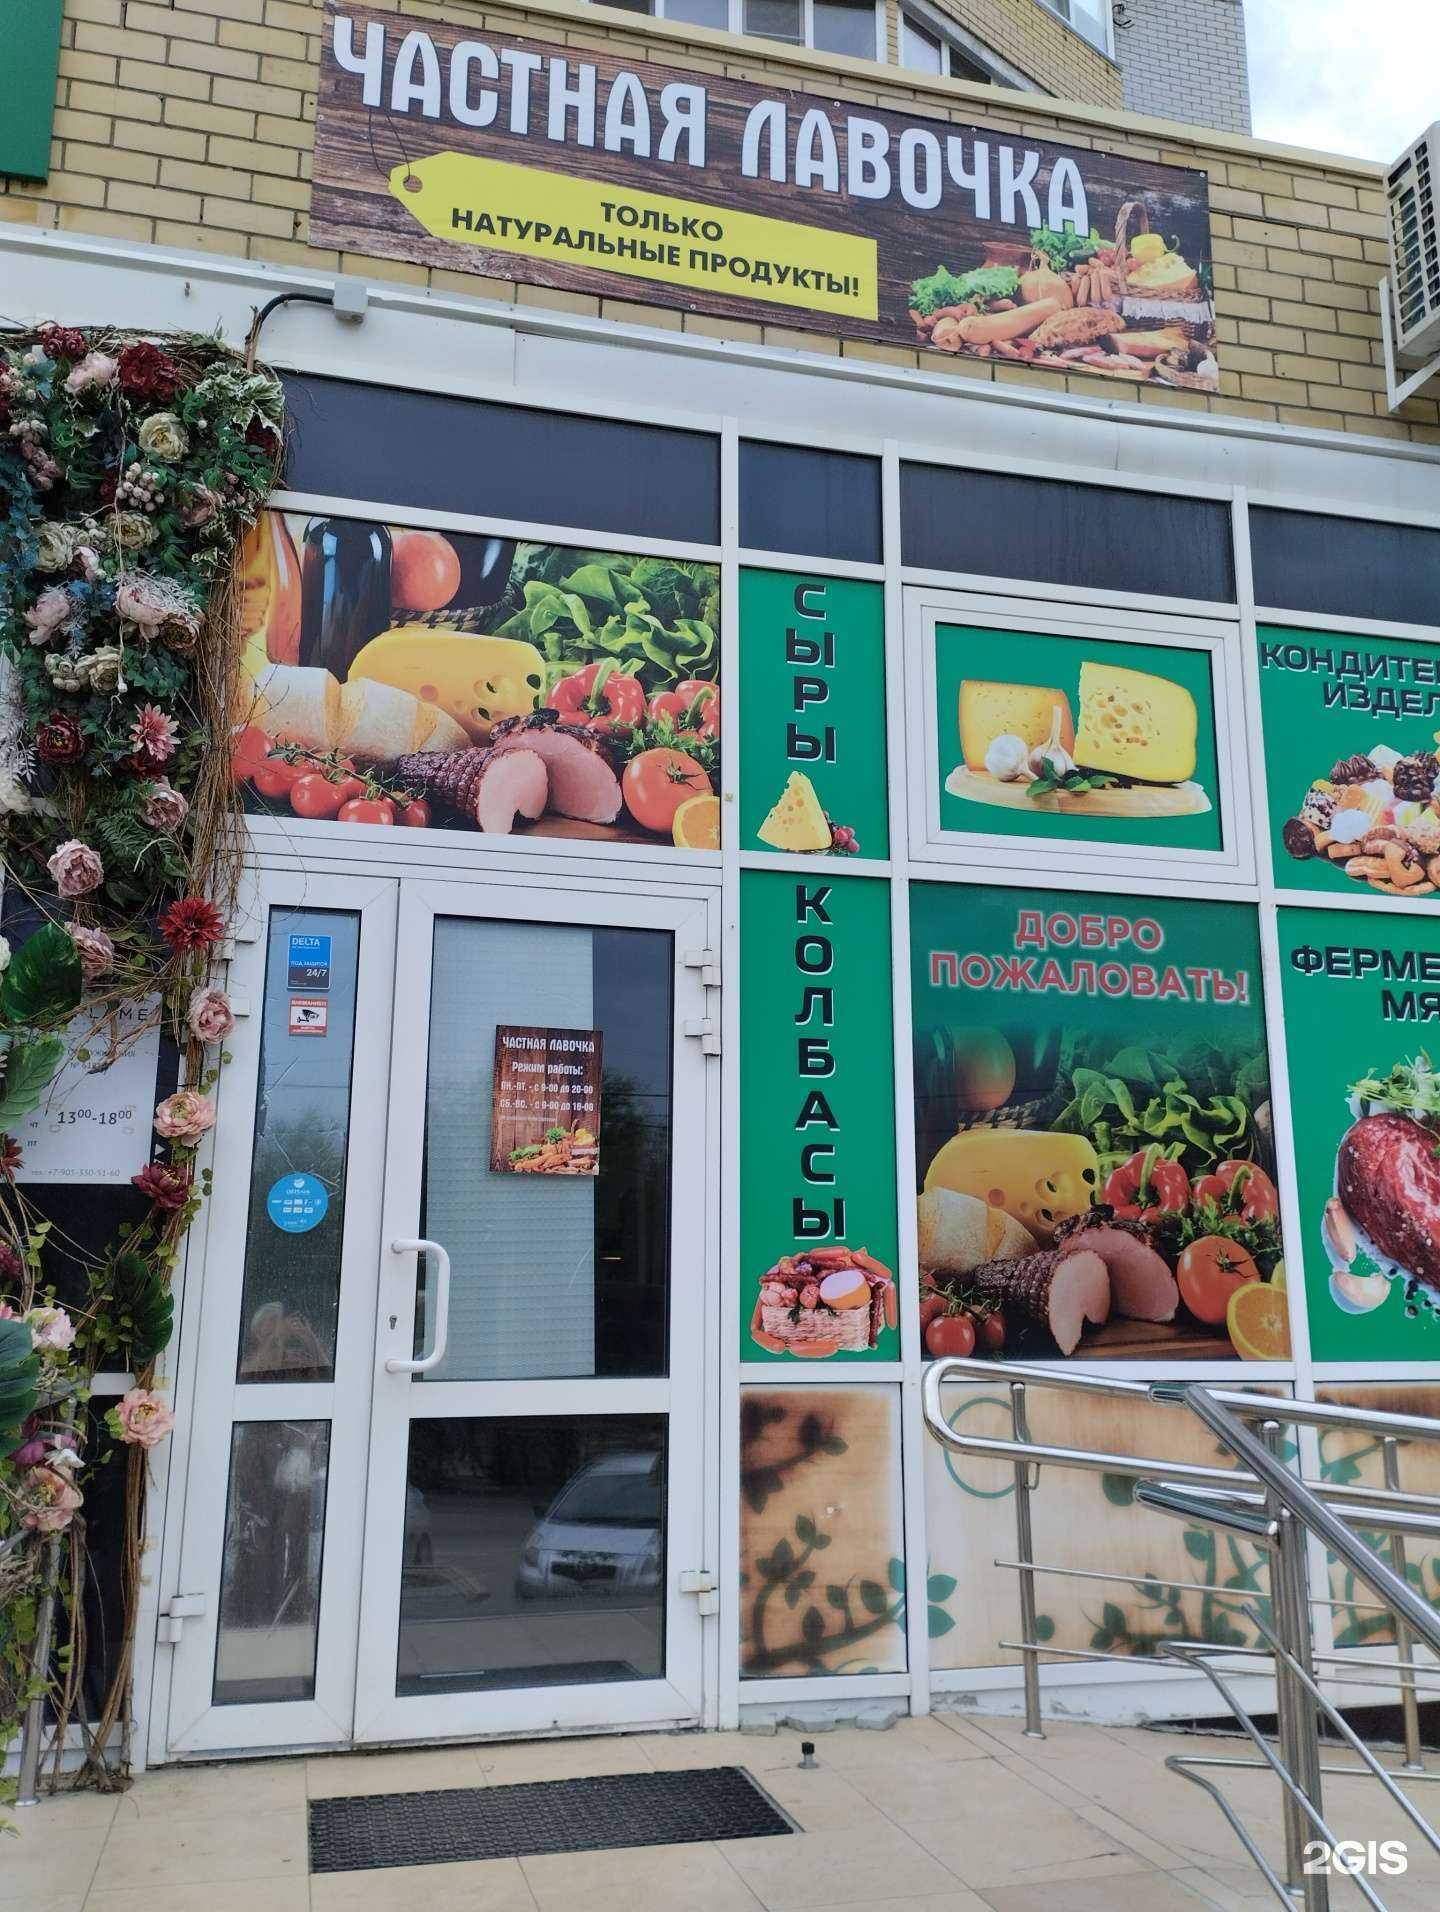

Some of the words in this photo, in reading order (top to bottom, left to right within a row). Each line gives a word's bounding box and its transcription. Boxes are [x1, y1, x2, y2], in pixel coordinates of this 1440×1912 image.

[333, 15, 706, 168] ЧАСТНАЯ
[741, 99, 1090, 238] ЛАВОЧКА
[600, 201, 723, 242] ТОЛЬКО
[451, 207, 681, 267] НАТУРАЛЬНЫЕ
[689, 248, 860, 298] ПРОДУКТЫ!
[786, 583, 836, 763] СЫРЫ
[1260, 641, 1440, 686] КОНДИТЕ
[291, 937, 321, 947] DELTA
[1013, 909, 1164, 951] ДОБРО
[306, 968, 328, 978] 24/7
[929, 950, 1249, 1004] ПОЖАЛОВАТЬ!
[1290, 944, 1440, 984] ФЕРМЕ
[1381, 989, 1440, 1023] МЯ
[502, 1036, 546, 1050] ЧАСТНАЯ
[549, 1038, 595, 1053] ЛАВОЧКА
[793, 885, 846, 1240] КОЛБАСЫ
[511, 1061, 545, 1073] Режим
